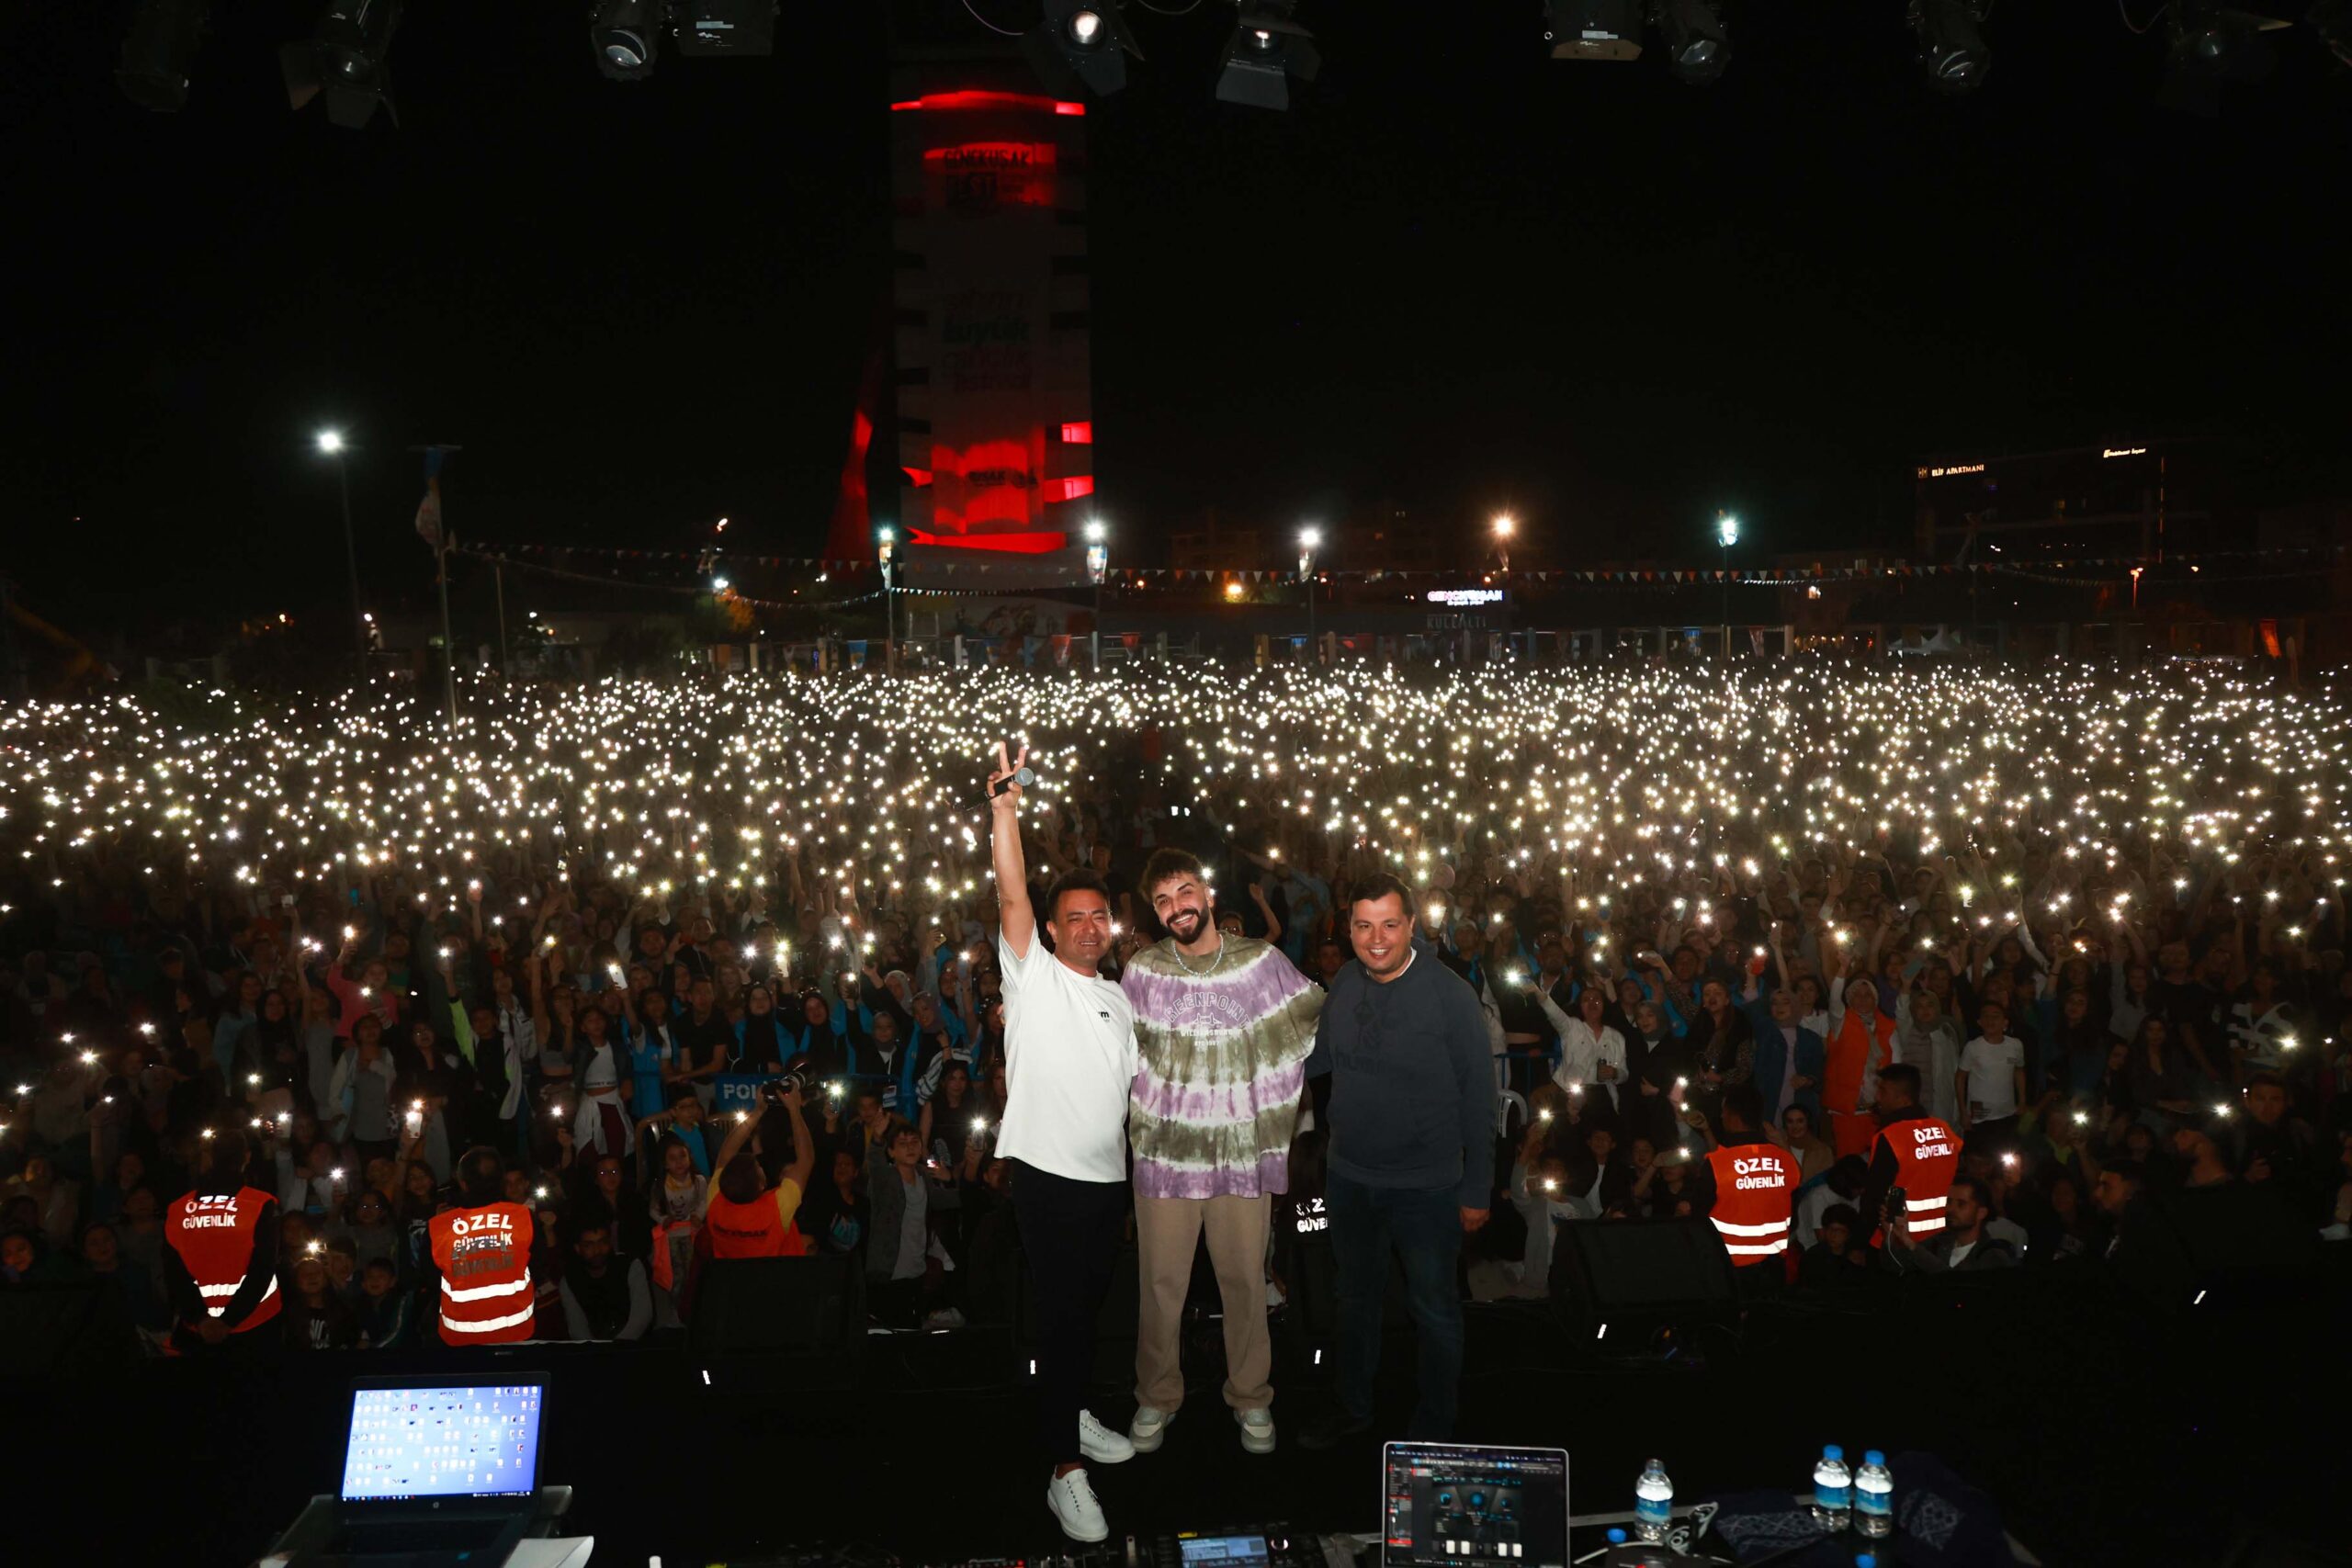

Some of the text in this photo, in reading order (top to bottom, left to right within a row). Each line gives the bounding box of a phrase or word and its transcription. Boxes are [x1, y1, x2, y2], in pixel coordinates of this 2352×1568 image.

[1931, 467, 1944, 477] ELİF
[1734, 1156, 1784, 1175] ÖZEL
[1736, 1173, 1785, 1190] GÜVENLİK
[185, 1194, 239, 1213] ÖZEL
[182, 1212, 236, 1229] GÜVENLİK
[452, 1213, 514, 1235] ÖZEL
